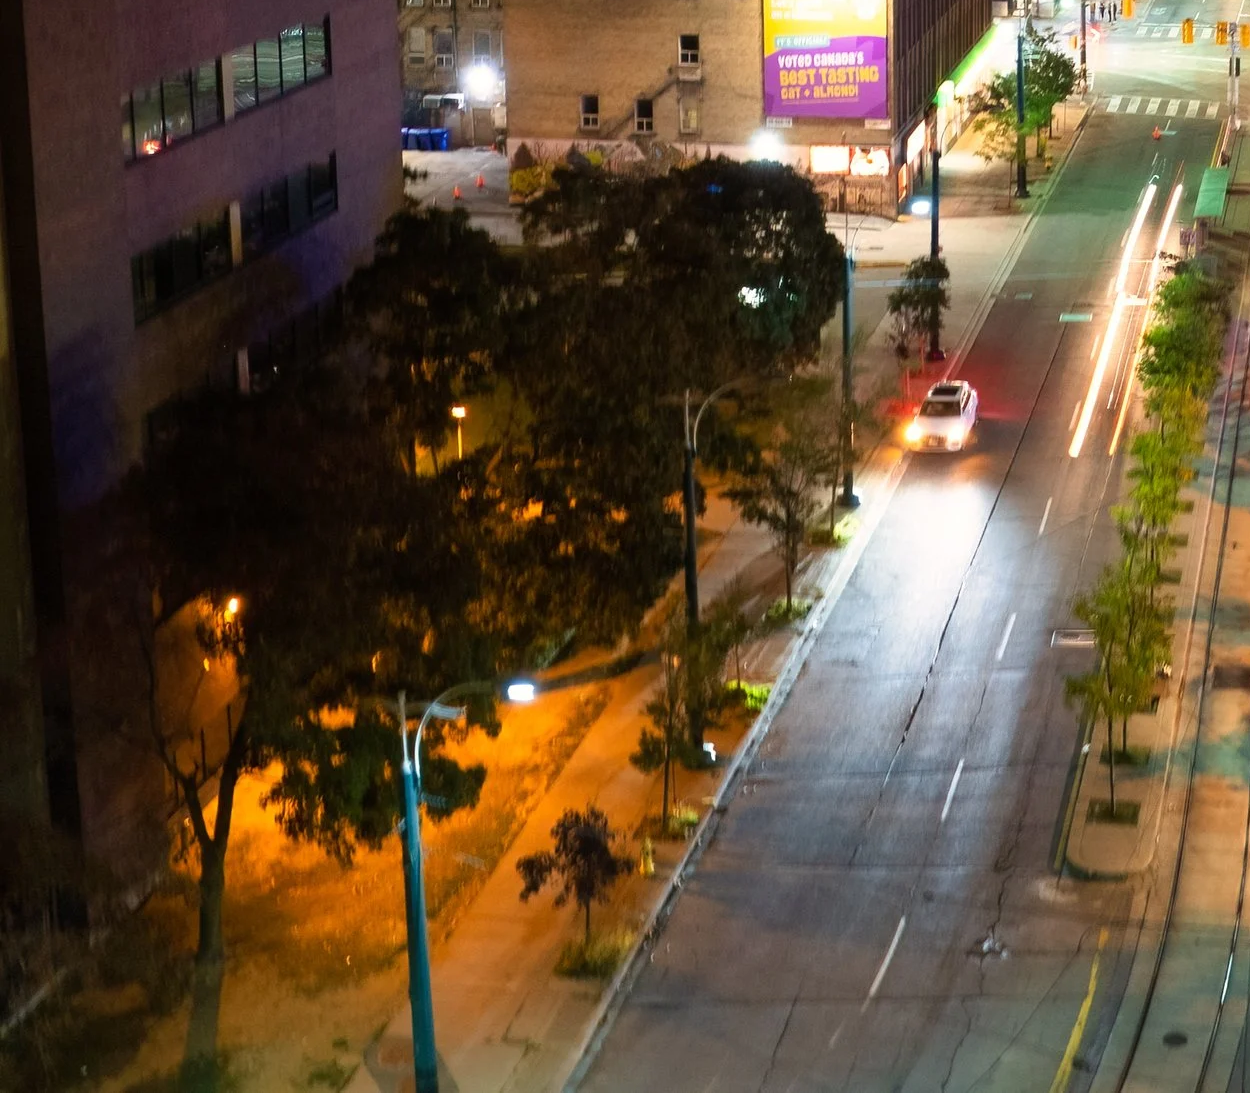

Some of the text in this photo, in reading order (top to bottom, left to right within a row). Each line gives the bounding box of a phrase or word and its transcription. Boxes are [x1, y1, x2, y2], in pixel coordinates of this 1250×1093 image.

[778, 51, 864, 68] VOTED CANADA'S
[780, 65, 879, 86] BEST TASTING
[781, 87, 801, 100] OAT
